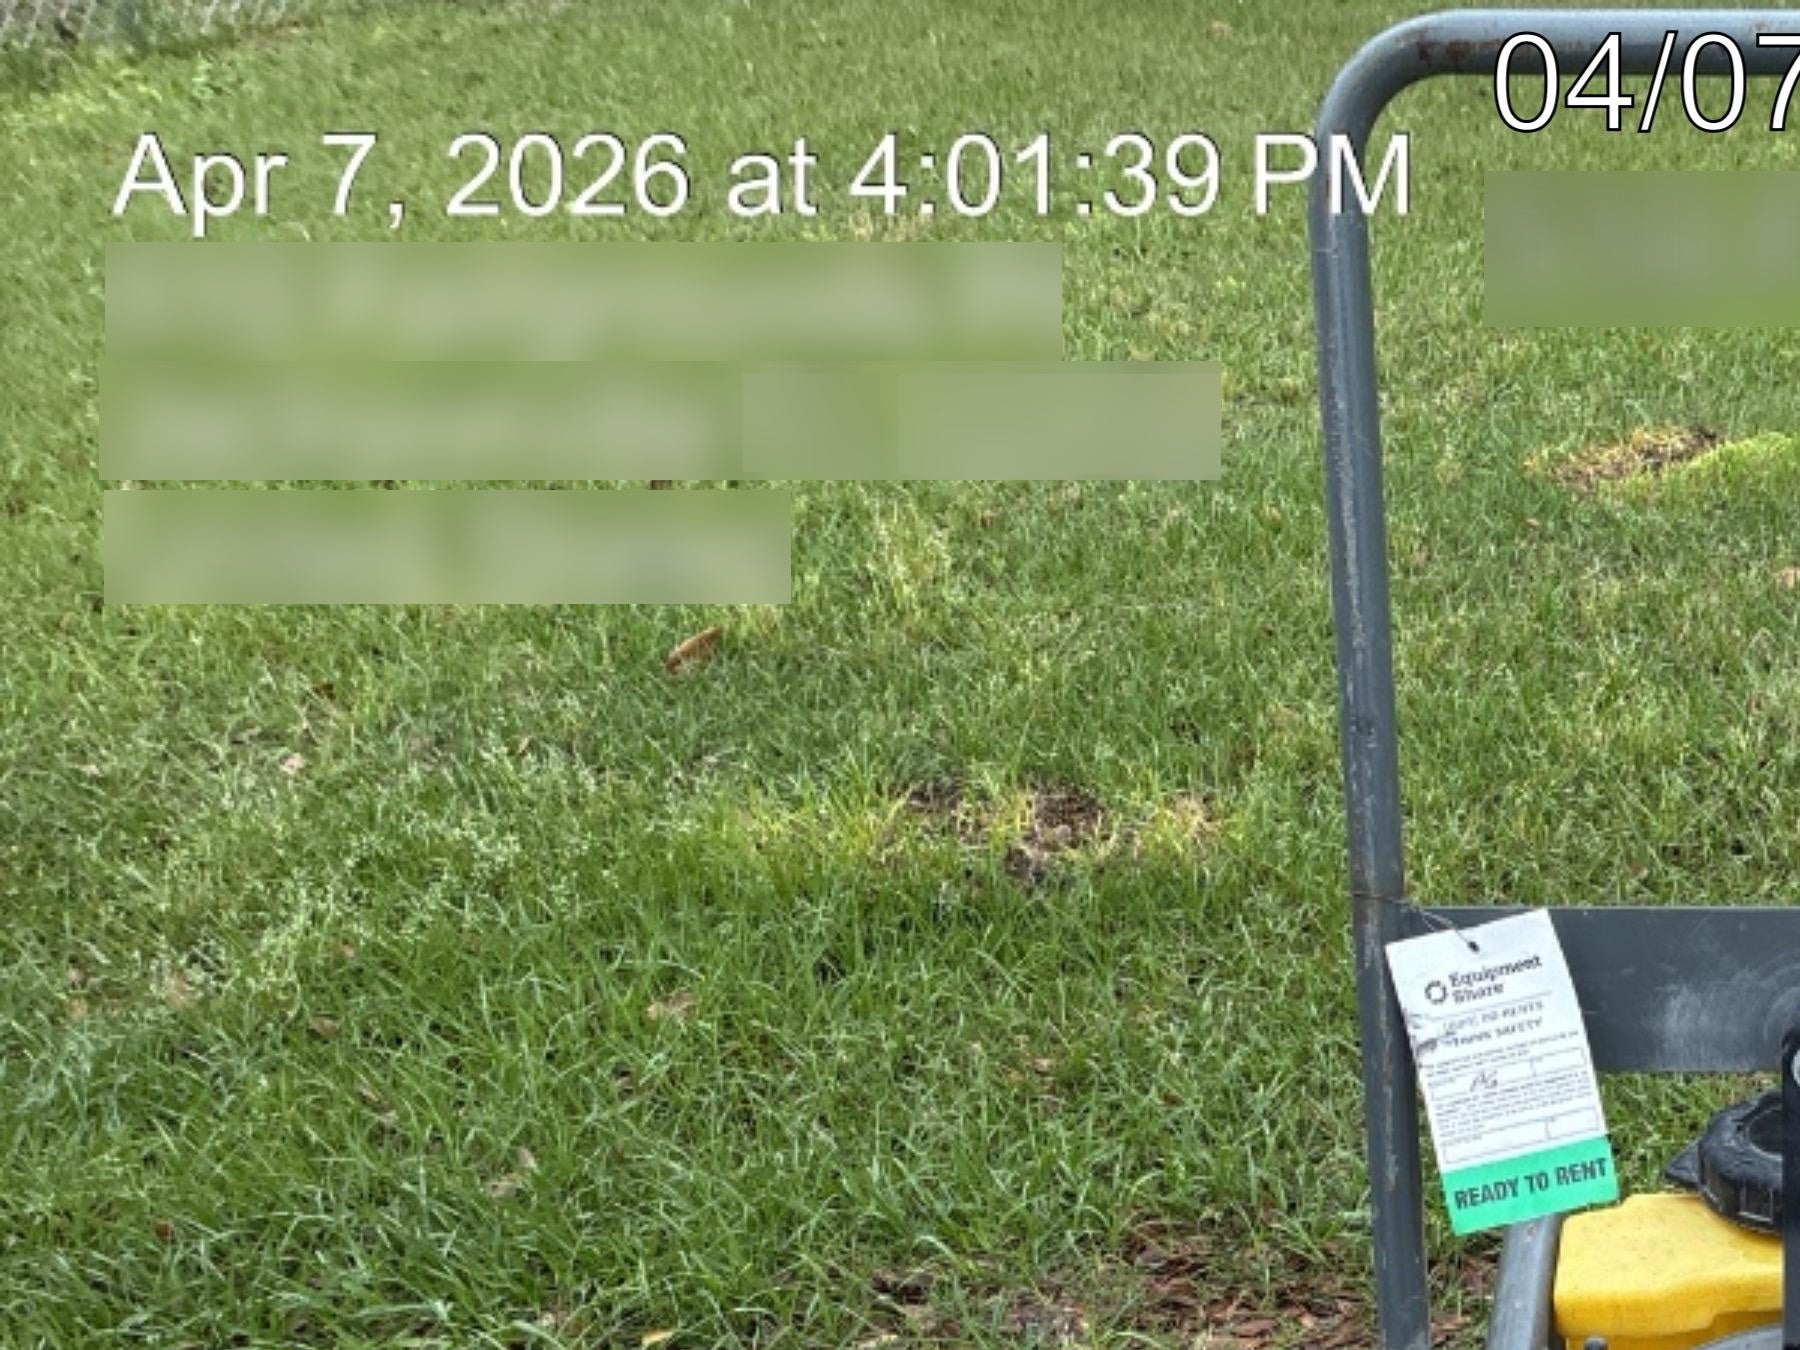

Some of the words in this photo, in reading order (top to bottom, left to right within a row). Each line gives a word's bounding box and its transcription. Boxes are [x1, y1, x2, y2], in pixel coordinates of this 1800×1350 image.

[1448, 954, 1543, 988] Equipment
[1452, 983, 1505, 1004] Share
[1454, 1175, 1520, 1210] READY
[1523, 1170, 1550, 1194] TO
[1555, 1157, 1607, 1186] RENT
